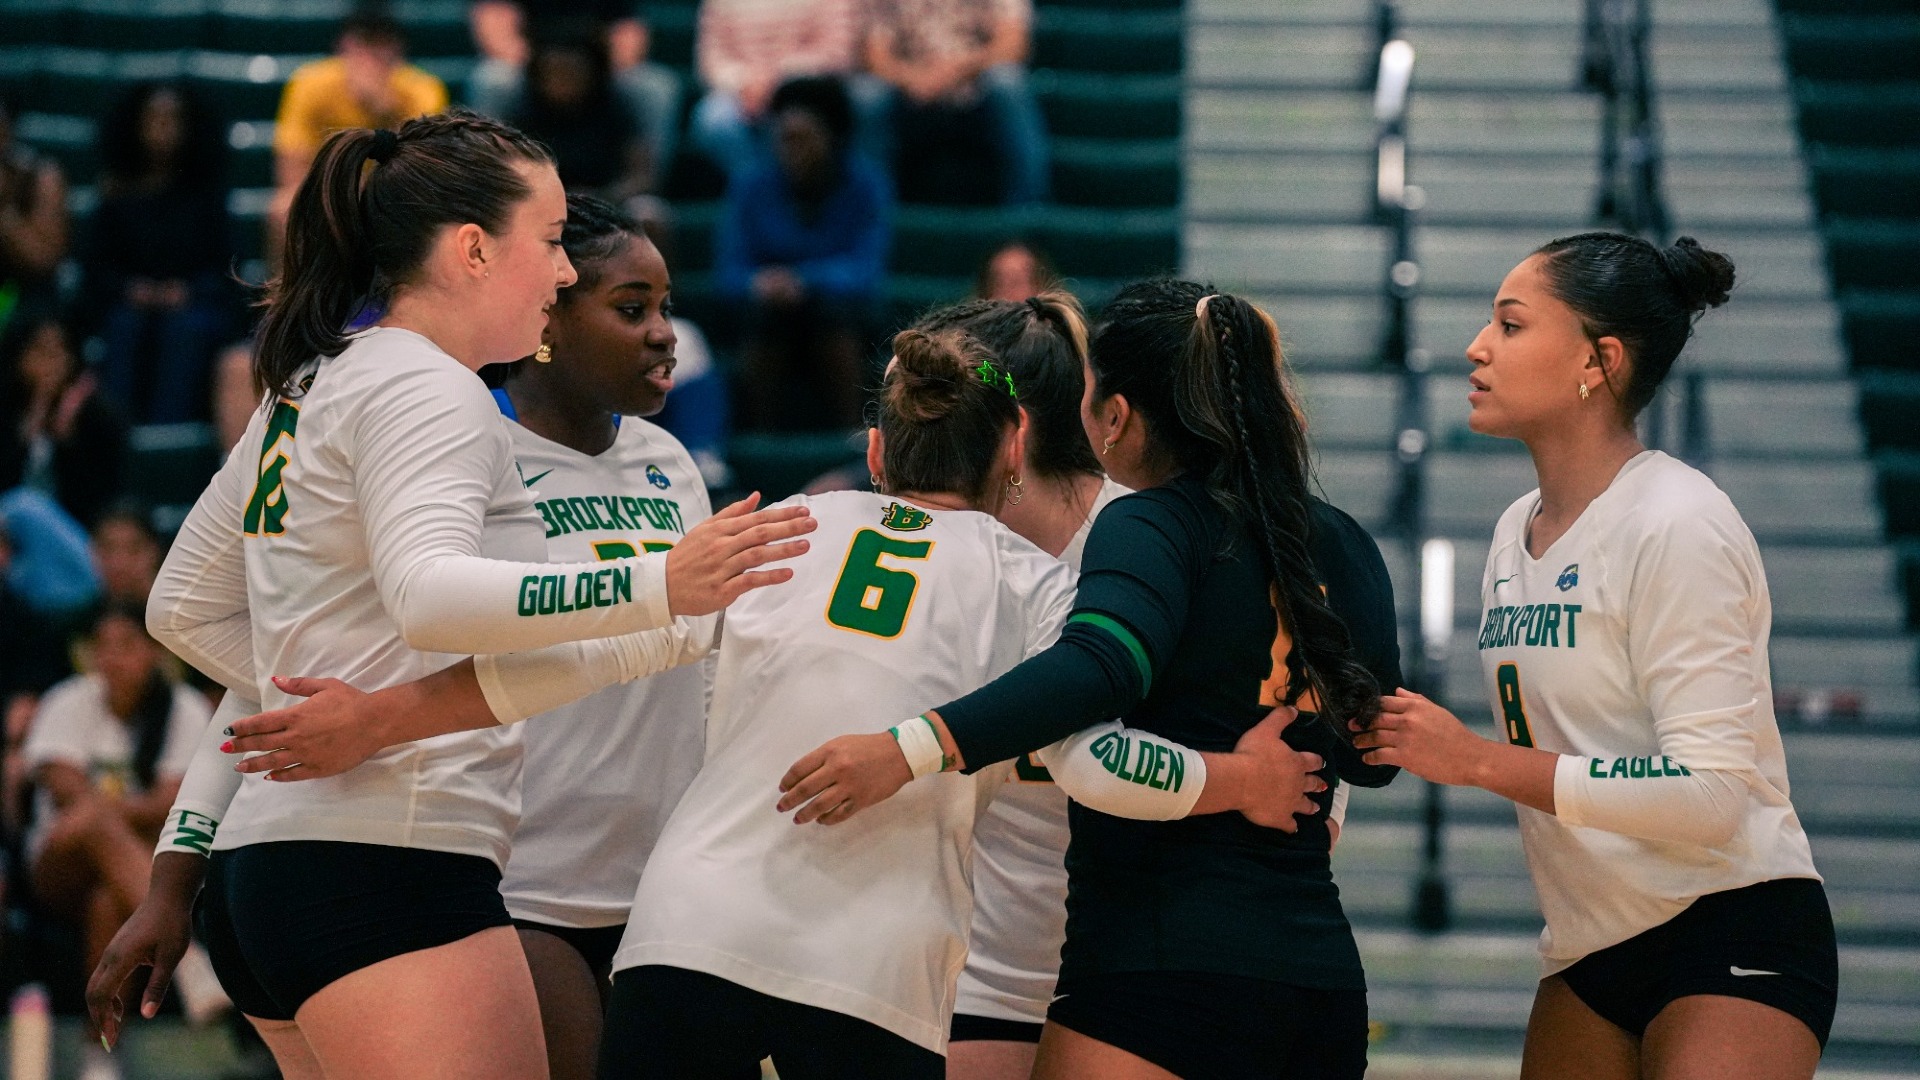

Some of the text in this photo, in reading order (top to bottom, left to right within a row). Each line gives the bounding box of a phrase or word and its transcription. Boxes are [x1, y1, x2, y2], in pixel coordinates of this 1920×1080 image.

[534, 495, 686, 539] BROCKPORT
[517, 566, 632, 616] GOLDEN
[824, 526, 937, 641] 6
[1478, 603, 1582, 650] BROCKPORT
[1495, 660, 1538, 749] 8
[1089, 731, 1185, 793] GOLDEN
[1589, 755, 1691, 778] EAGLE
